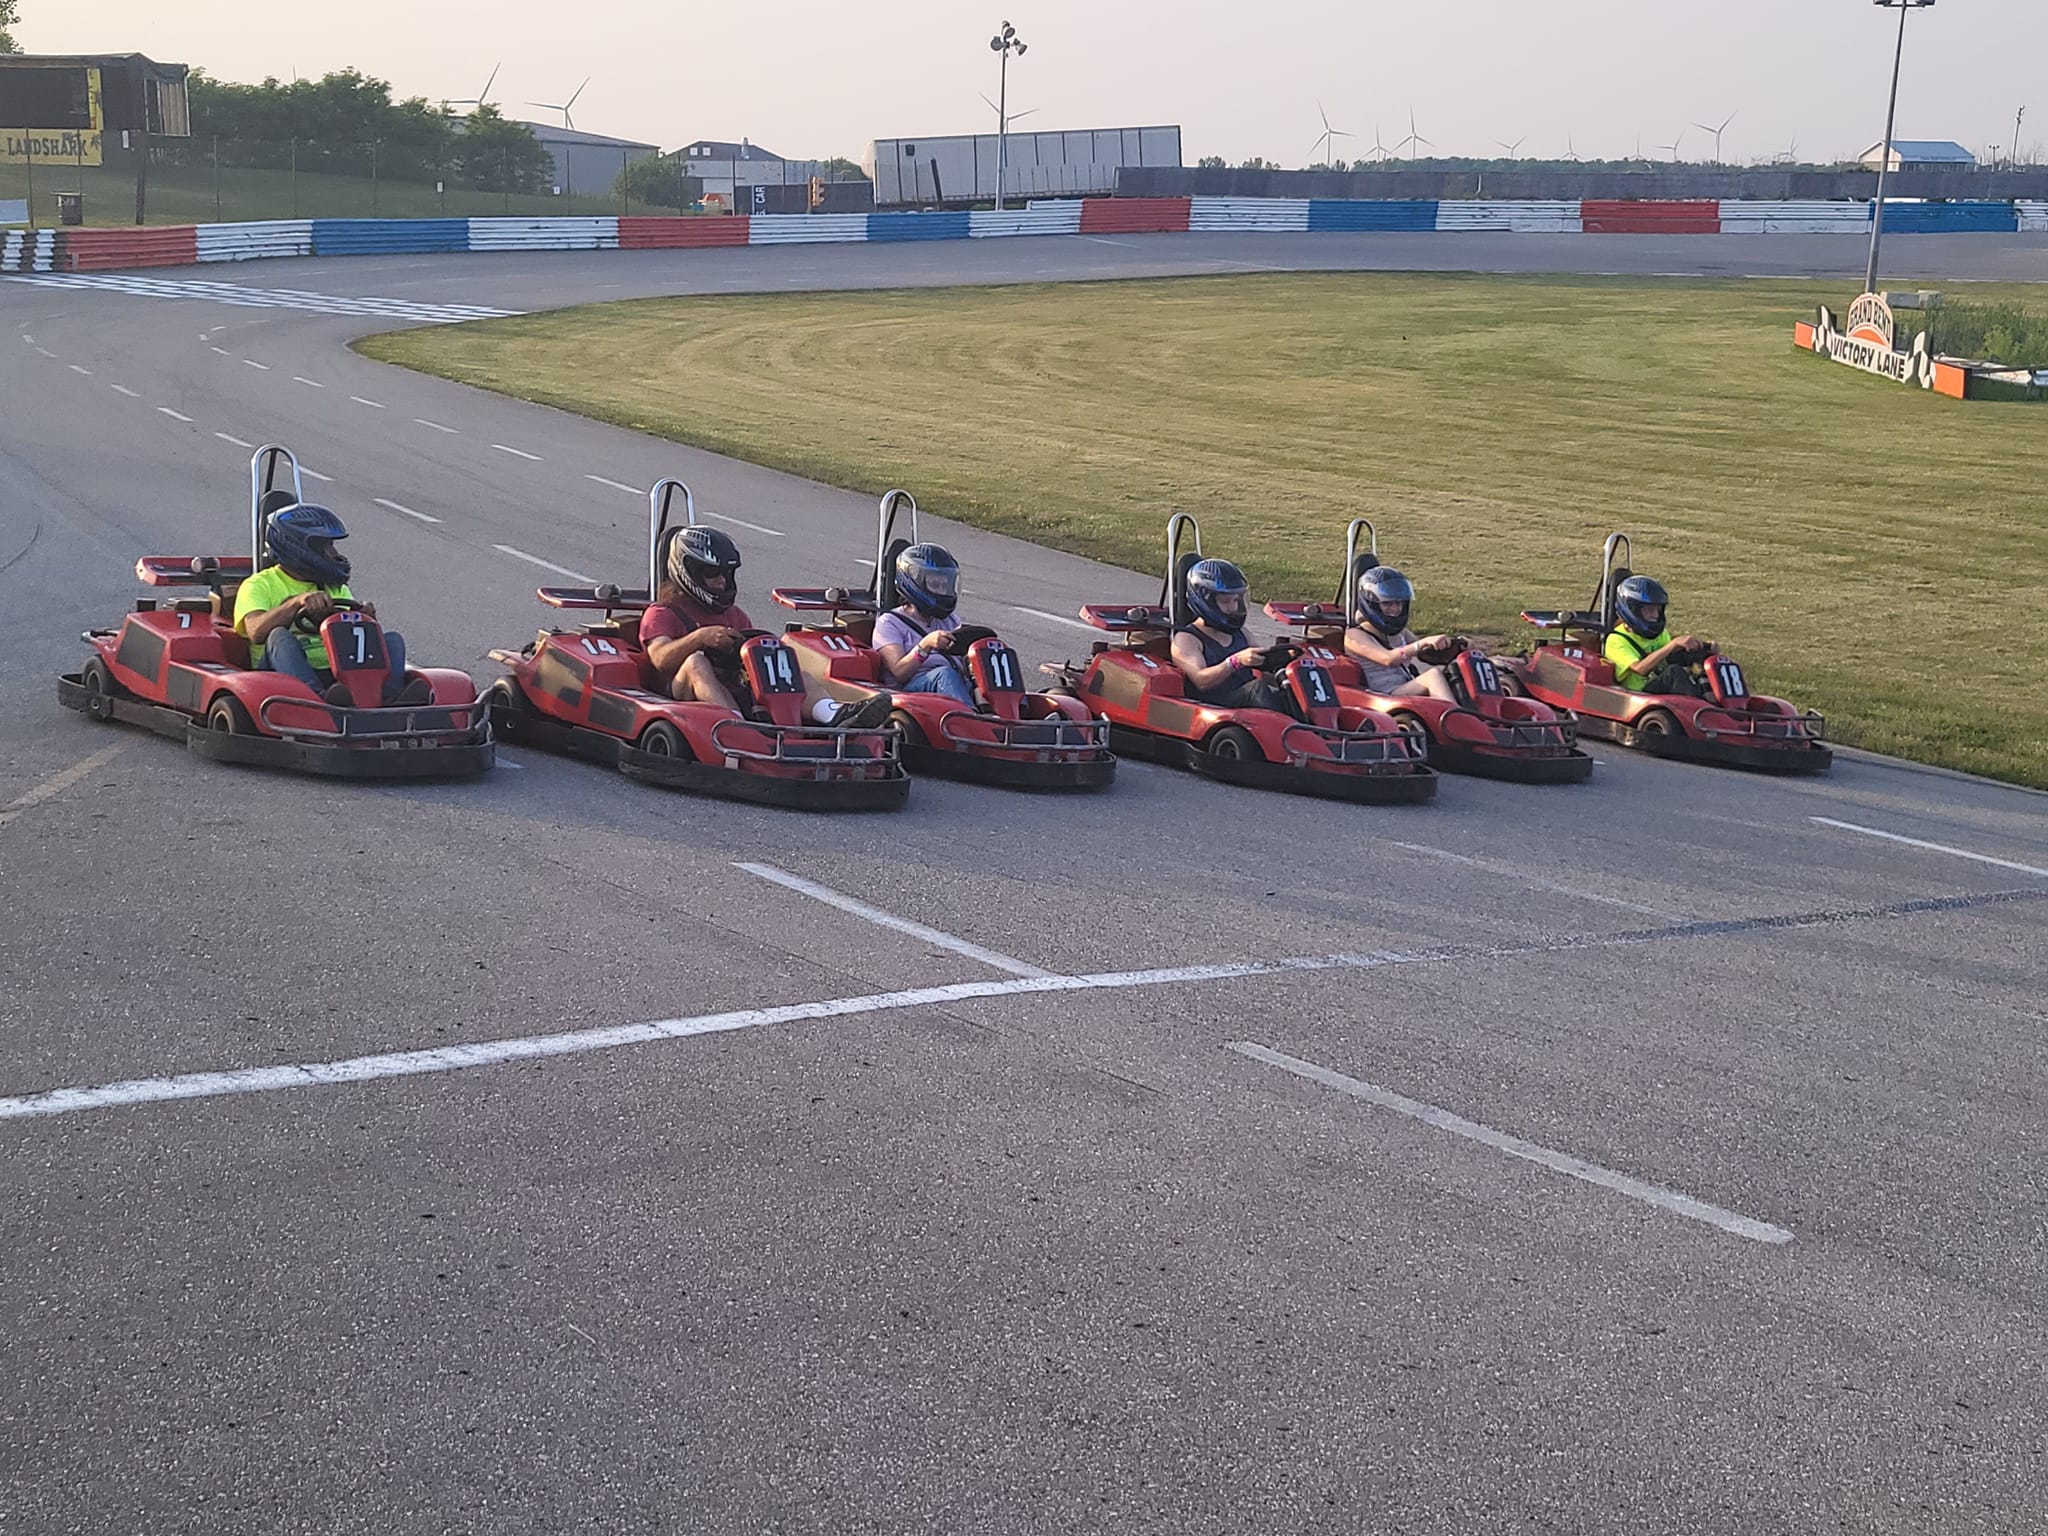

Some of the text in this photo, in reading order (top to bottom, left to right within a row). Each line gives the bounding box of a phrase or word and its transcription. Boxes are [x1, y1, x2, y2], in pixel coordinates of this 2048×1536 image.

[7, 135, 88, 156] LANDSHARK
[755, 186, 766, 204] CAR
[1873, 300, 1891, 344] BEND
[1833, 337, 1905, 379] VICTORY LANE
[580, 638, 618, 655] 14
[821, 634, 850, 651] 11
[1307, 645, 1336, 660] 15
[763, 649, 793, 686] 14
[989, 652, 1013, 688] 11
[1475, 661, 1497, 692] 15
[1719, 664, 1744, 696] 18
[1309, 670, 1327, 702] 3
